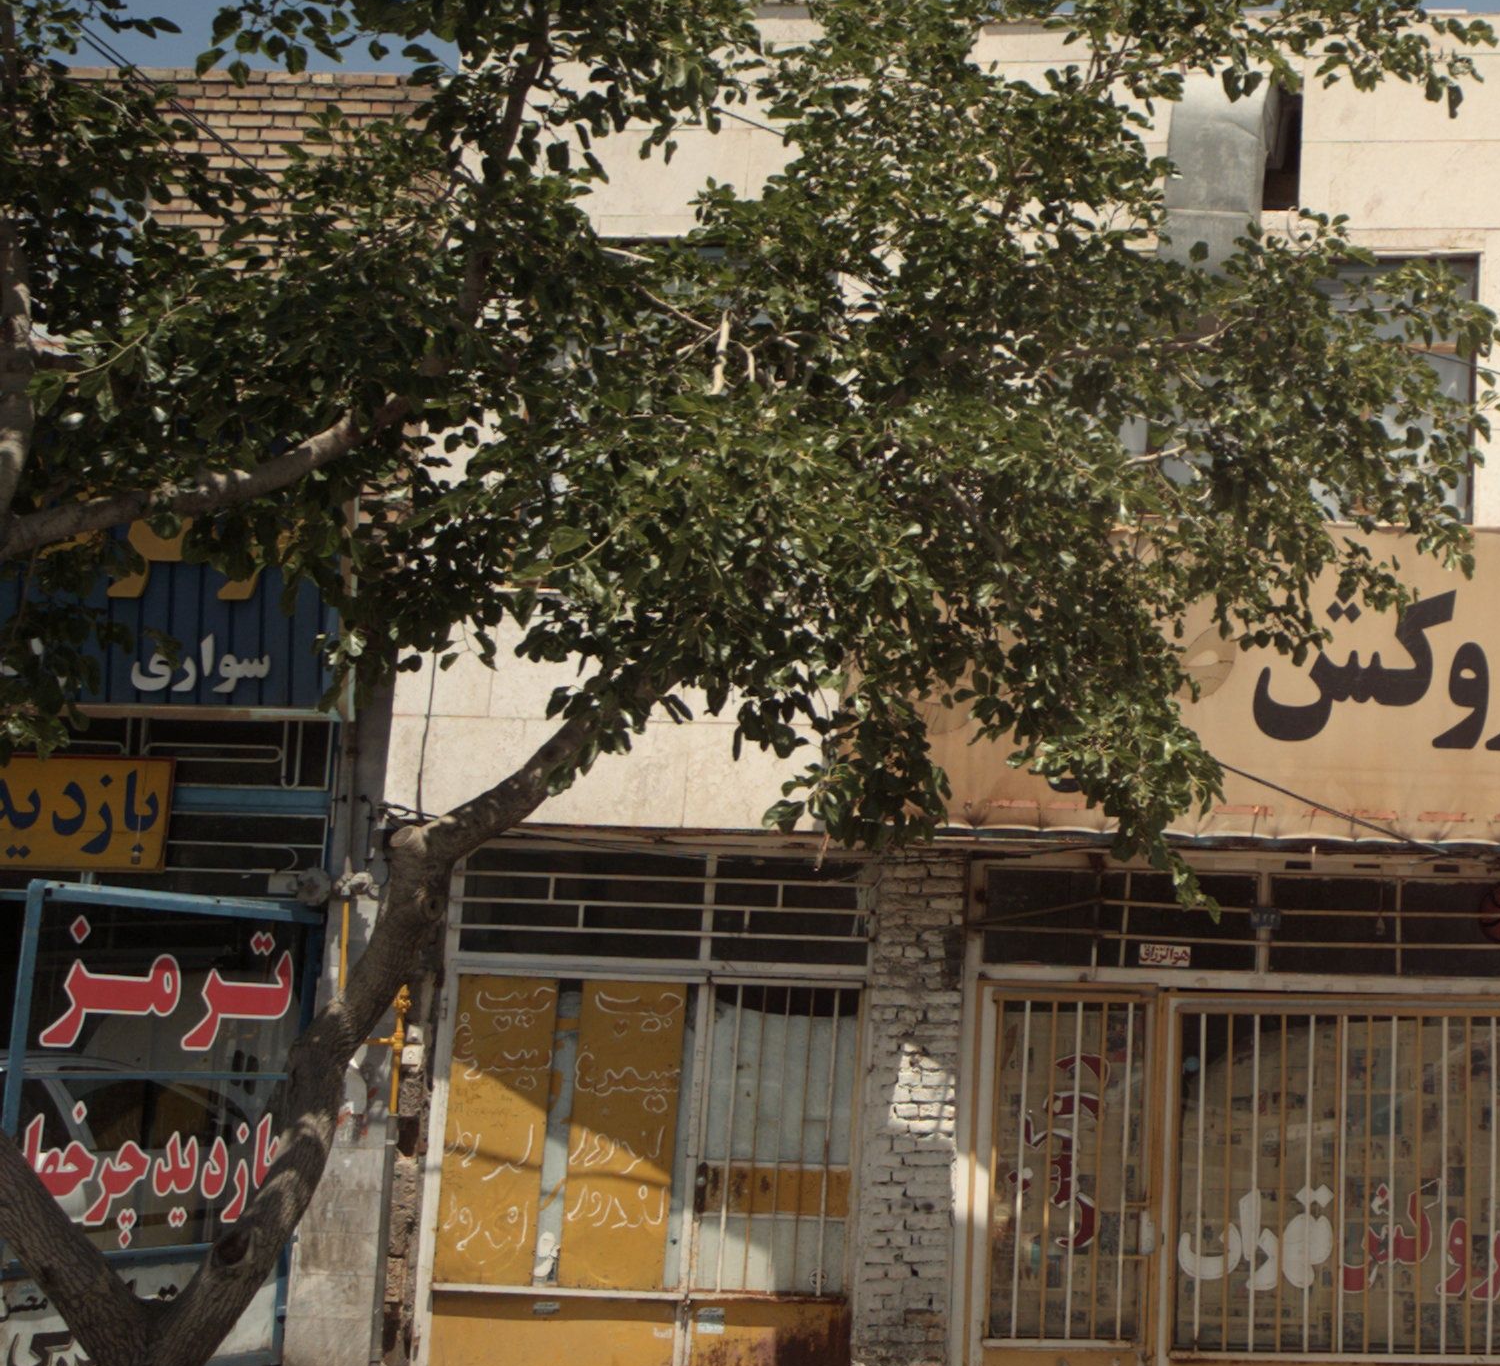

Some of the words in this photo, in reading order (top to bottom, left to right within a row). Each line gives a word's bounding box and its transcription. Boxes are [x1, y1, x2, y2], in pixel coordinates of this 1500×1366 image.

[130, 633, 271, 693] سواری
[39, 915, 293, 1050] ترمز
[153, 1112, 281, 1228] ازدید
